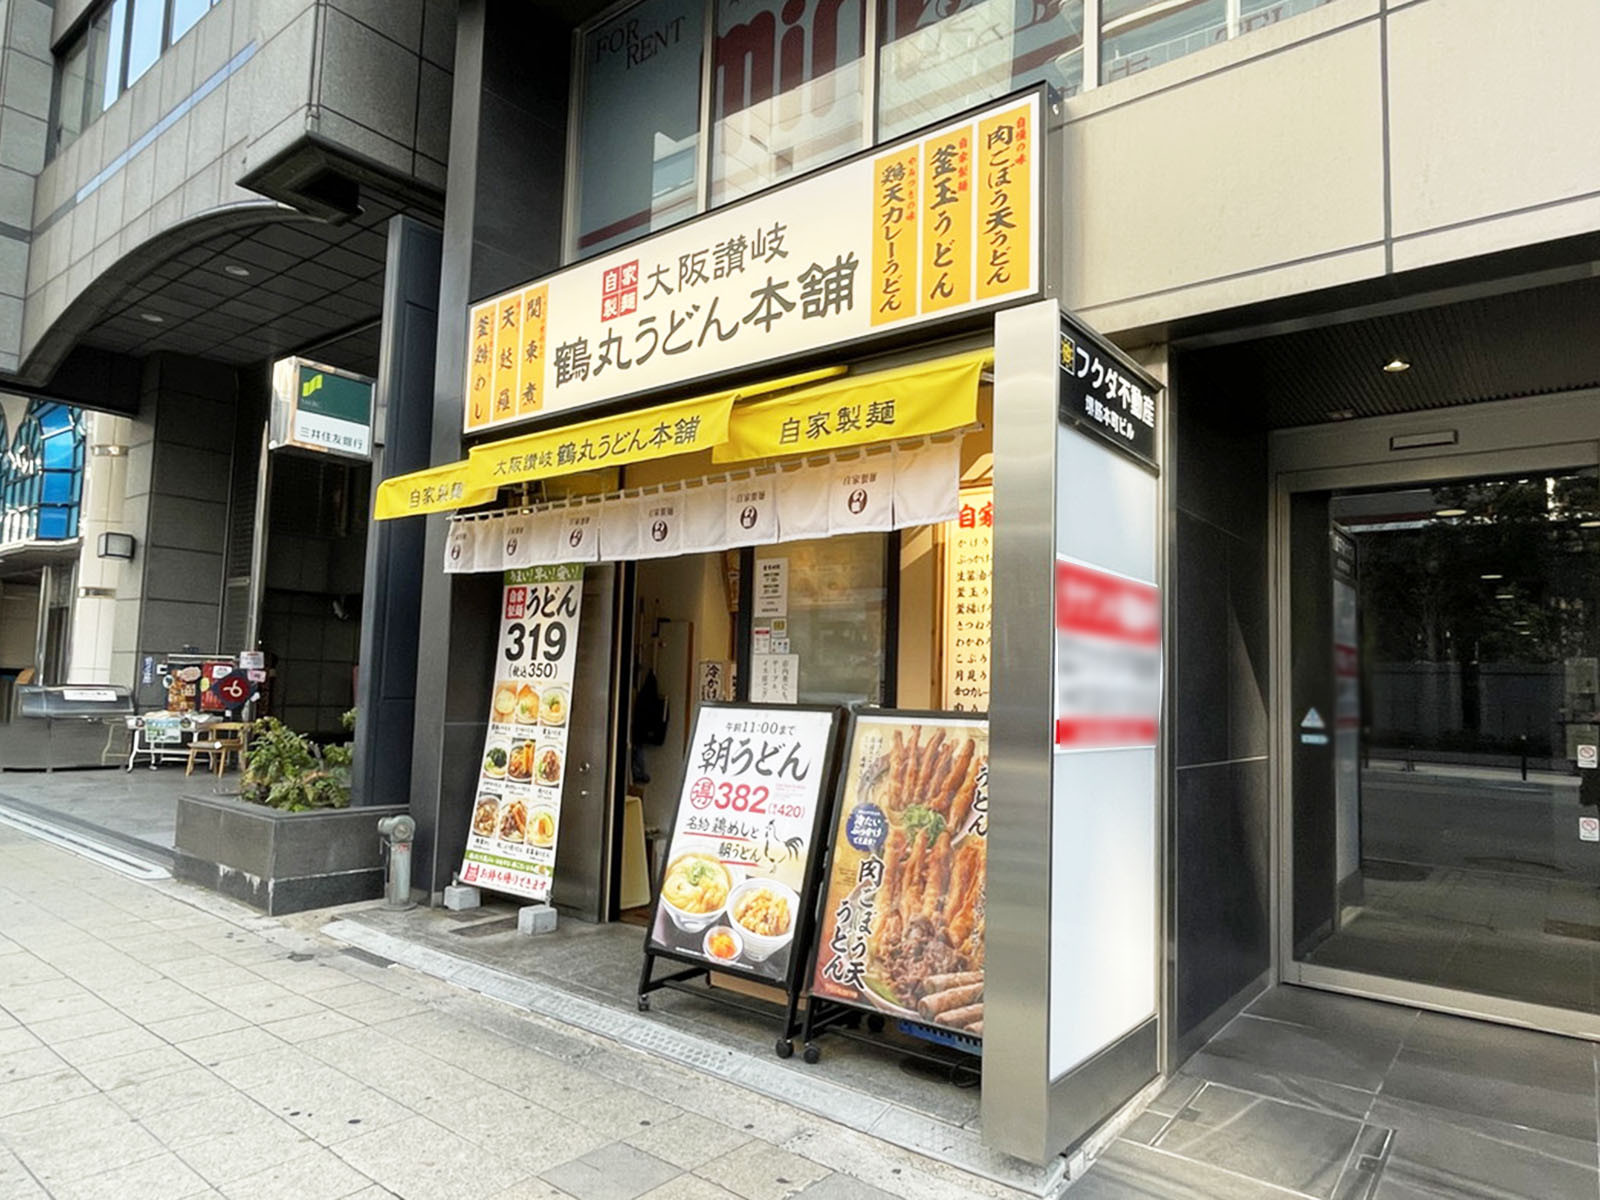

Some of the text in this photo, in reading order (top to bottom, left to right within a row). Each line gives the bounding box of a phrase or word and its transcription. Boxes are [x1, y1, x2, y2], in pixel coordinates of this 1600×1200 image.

[596, 20, 640, 63] FOR
[625, 15, 686, 70] RENT
[929, 144, 960, 300] 釜玉うどん
[643, 222, 790, 301] 大阪讃岐
[553, 250, 860, 389] 鶴丸うどん本舗
[1076, 346, 1155, 429] フクダ不動産
[299, 426, 363, 449] 三井住友銀行
[556, 415, 701, 468] 鶴丸うどん本舗
[779, 400, 896, 445] 自家製麺
[526, 584, 578, 619] うどん
[504, 621, 567, 662] 319
[725, 721, 797, 736] 午前11:00まで
[697, 733, 811, 782] 朝うどん
[714, 781, 770, 814] 382
